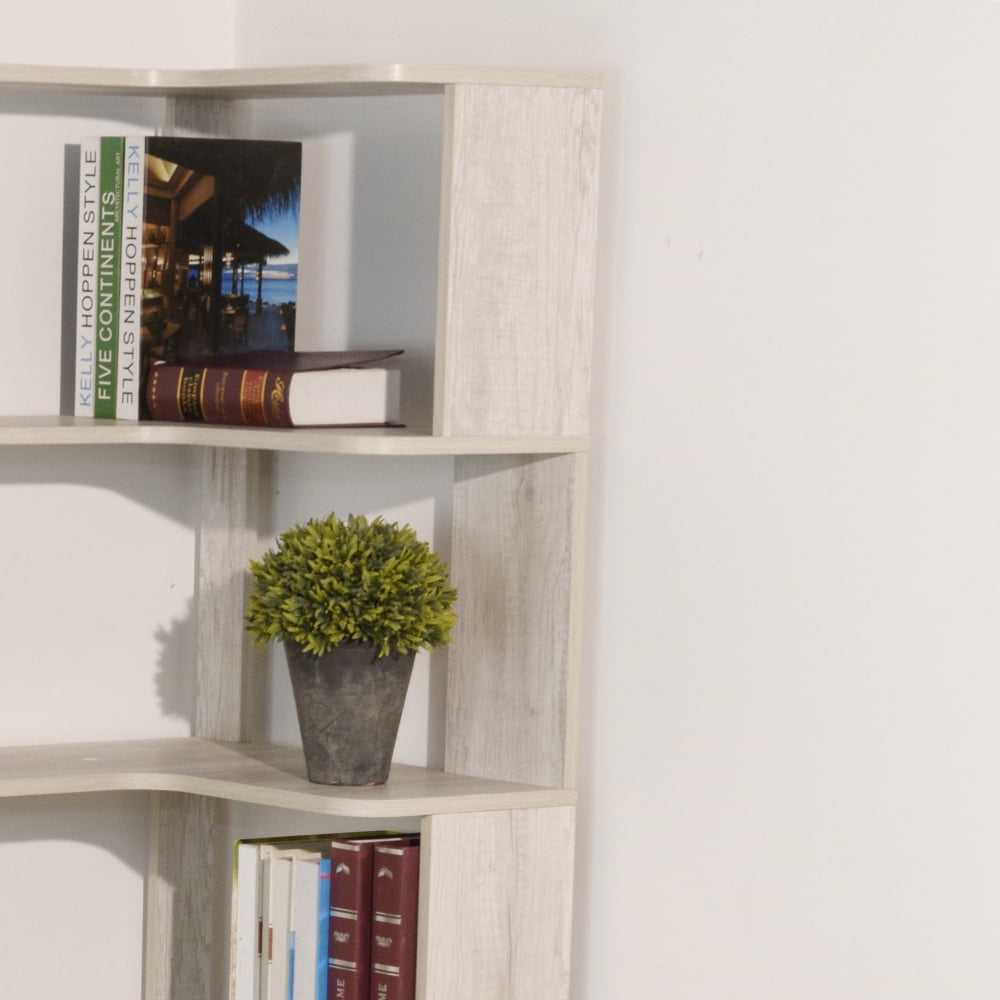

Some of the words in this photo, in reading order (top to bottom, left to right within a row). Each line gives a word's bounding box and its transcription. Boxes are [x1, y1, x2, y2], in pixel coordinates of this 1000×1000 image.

[83, 150, 97, 224] STYLE
[127, 145, 140, 219] KELLY
[81, 231, 96, 328] HOPPEN
[99, 191, 115, 342] CONTINENTS
[123, 226, 138, 324] HOPPEN
[80, 335, 93, 407] KELLY
[98, 349, 112, 400] FIVE
[121, 331, 135, 405] STYLE
